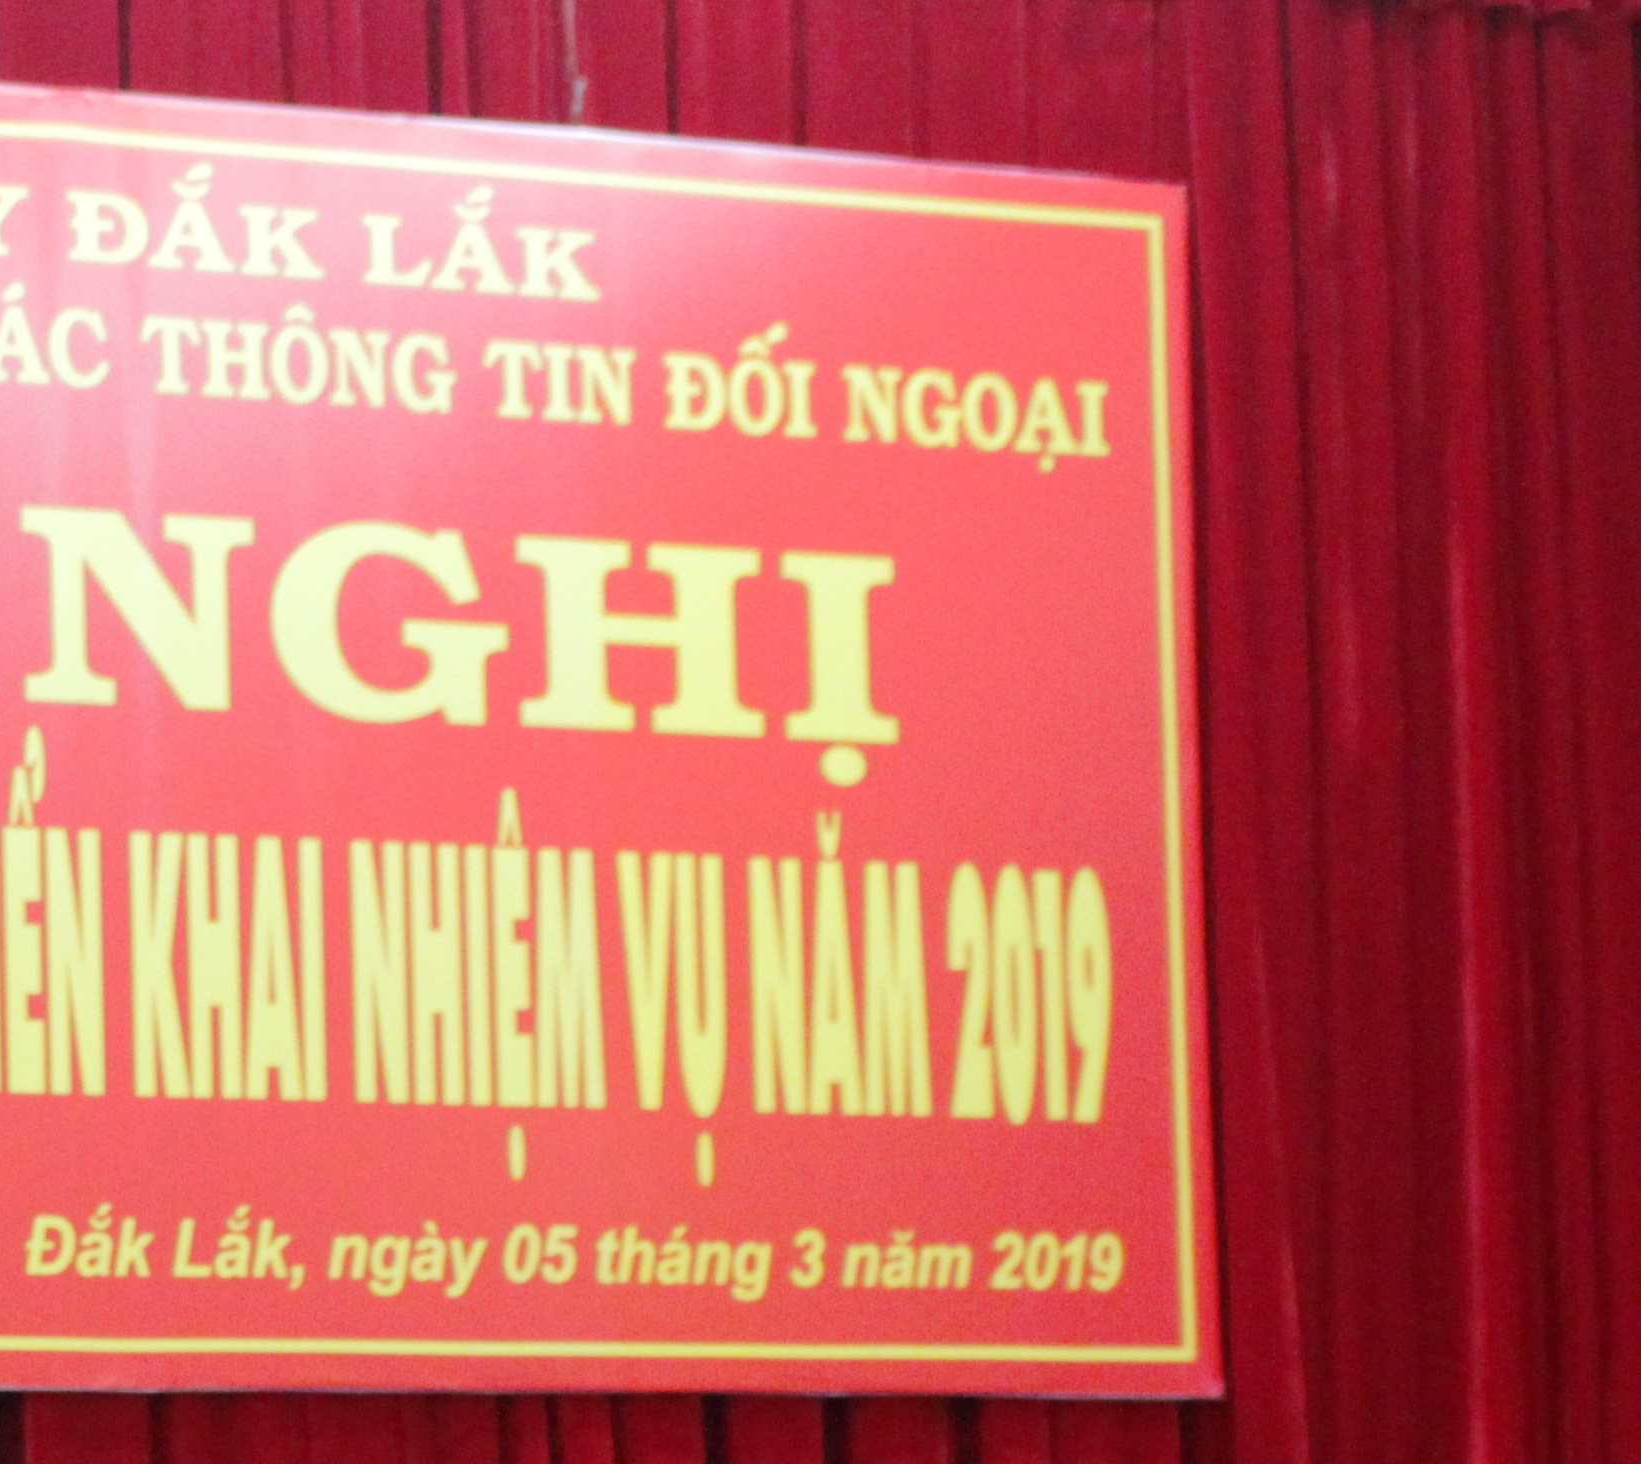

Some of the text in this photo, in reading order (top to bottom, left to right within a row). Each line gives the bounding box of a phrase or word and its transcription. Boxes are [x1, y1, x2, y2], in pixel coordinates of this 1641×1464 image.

[67, 162, 324, 278] ĐẮK
[362, 185, 602, 302] LẮK
[142, 304, 457, 415] THÔNG
[484, 340, 635, 425] TIN
[664, 322, 817, 443] ĐỐI
[843, 367, 1110, 474] NGOẠI
[19, 505, 900, 787] NGHỊ
[128, 829, 328, 1102] KHAI
[349, 787, 607, 1181] NHIỆM
[616, 850, 726, 1187] VỤ
[747, 810, 933, 1118] NĂM
[946, 863, 1112, 1125] 2019
[25, 1203, 1124, 1301] Đắk Lắk, ngày 05 tháng 3 năm 2019
